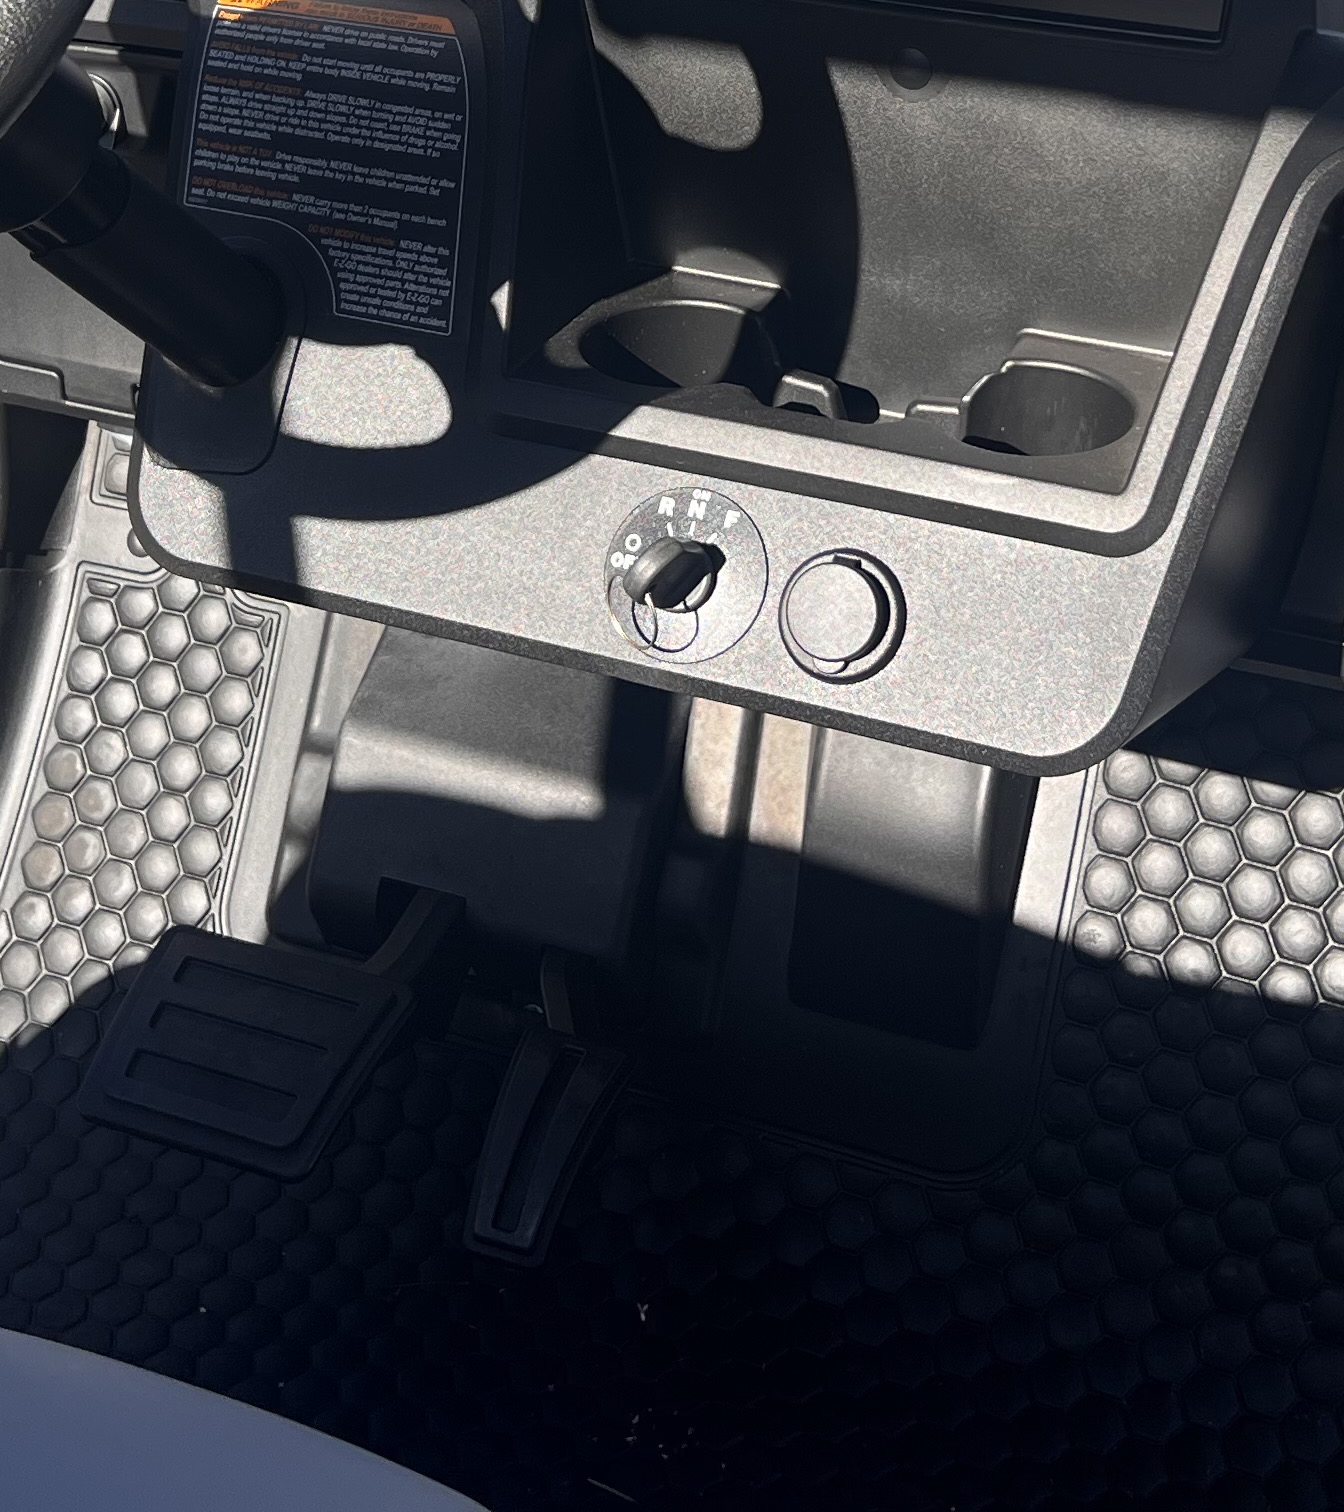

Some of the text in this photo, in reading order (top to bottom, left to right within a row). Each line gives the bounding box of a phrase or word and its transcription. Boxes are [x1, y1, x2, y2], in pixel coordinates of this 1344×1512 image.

[657, 496, 676, 517] R
[687, 499, 707, 520] N
[723, 510, 741, 528] F
[610, 551, 640, 570] OF
